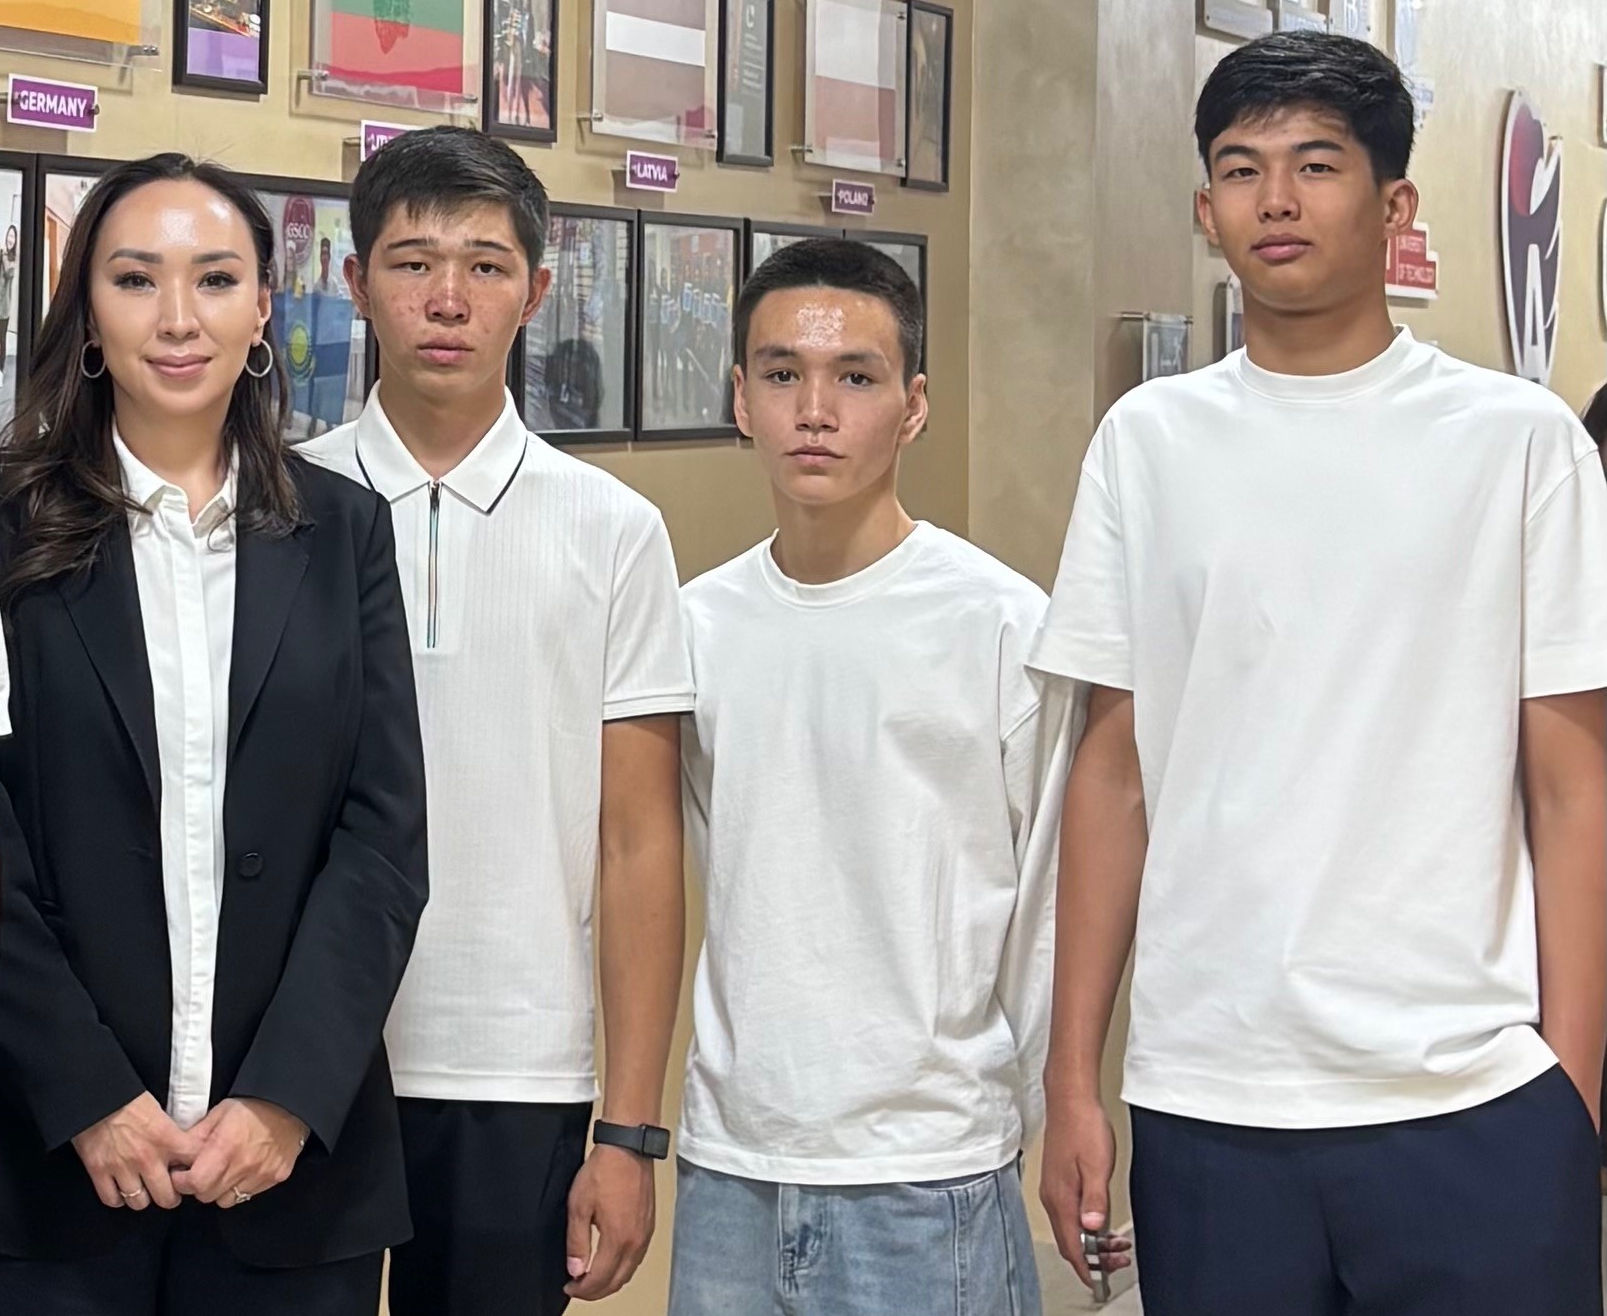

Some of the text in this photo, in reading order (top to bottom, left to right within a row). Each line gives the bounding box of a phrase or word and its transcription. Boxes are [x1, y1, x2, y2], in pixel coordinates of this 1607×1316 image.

[19, 90, 87, 118] GERMANY
[637, 162, 668, 181] LATVIA
[838, 189, 869, 207] POLAND
